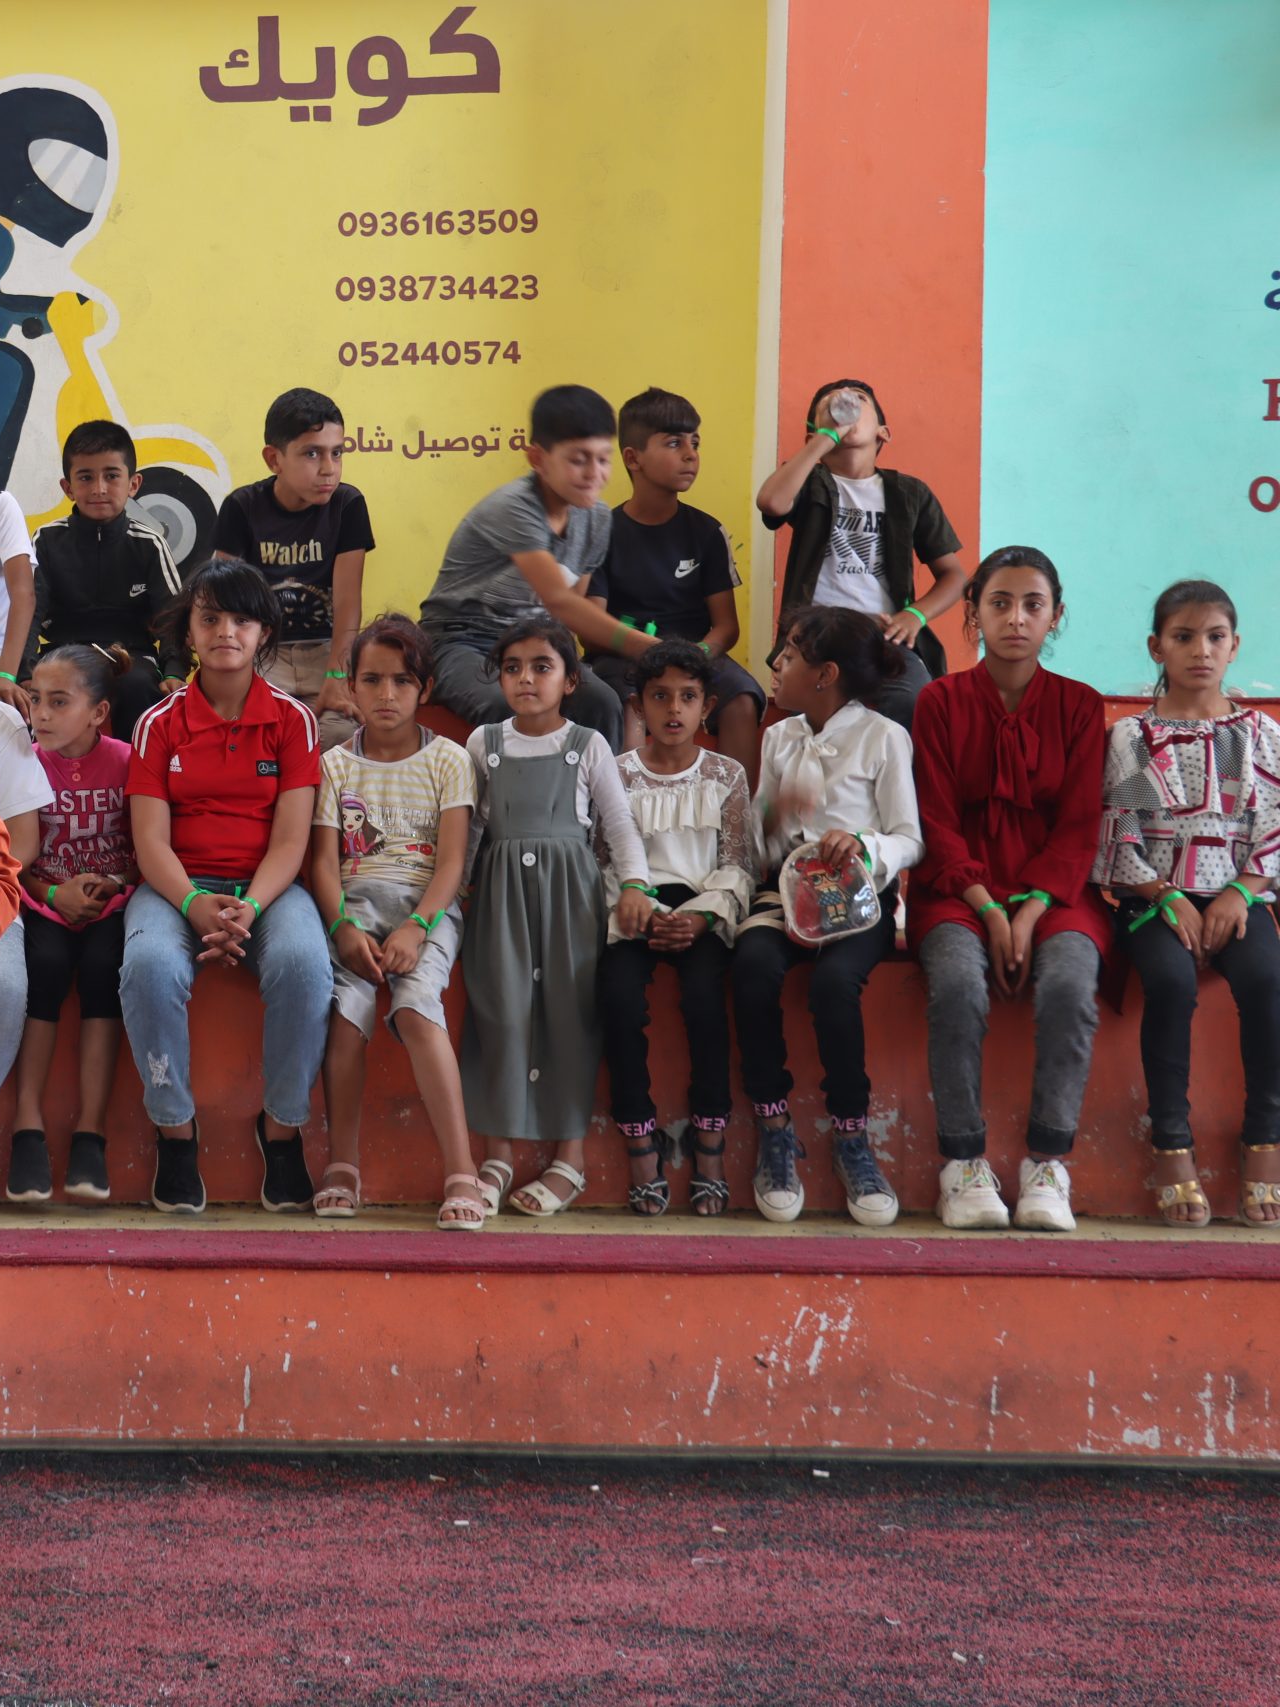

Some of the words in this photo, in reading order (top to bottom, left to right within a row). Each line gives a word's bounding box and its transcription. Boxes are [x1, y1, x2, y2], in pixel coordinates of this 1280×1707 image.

[199, 6, 501, 127] كويك
[338, 208, 539, 237] 0936163509
[335, 275, 539, 302] 0938734423
[338, 340, 522, 367] 052440574
[342, 425, 393, 454] شام
[401, 426, 501, 460] توصيل
[260, 539, 323, 566] Watch
[40, 786, 124, 813] ISTEN
